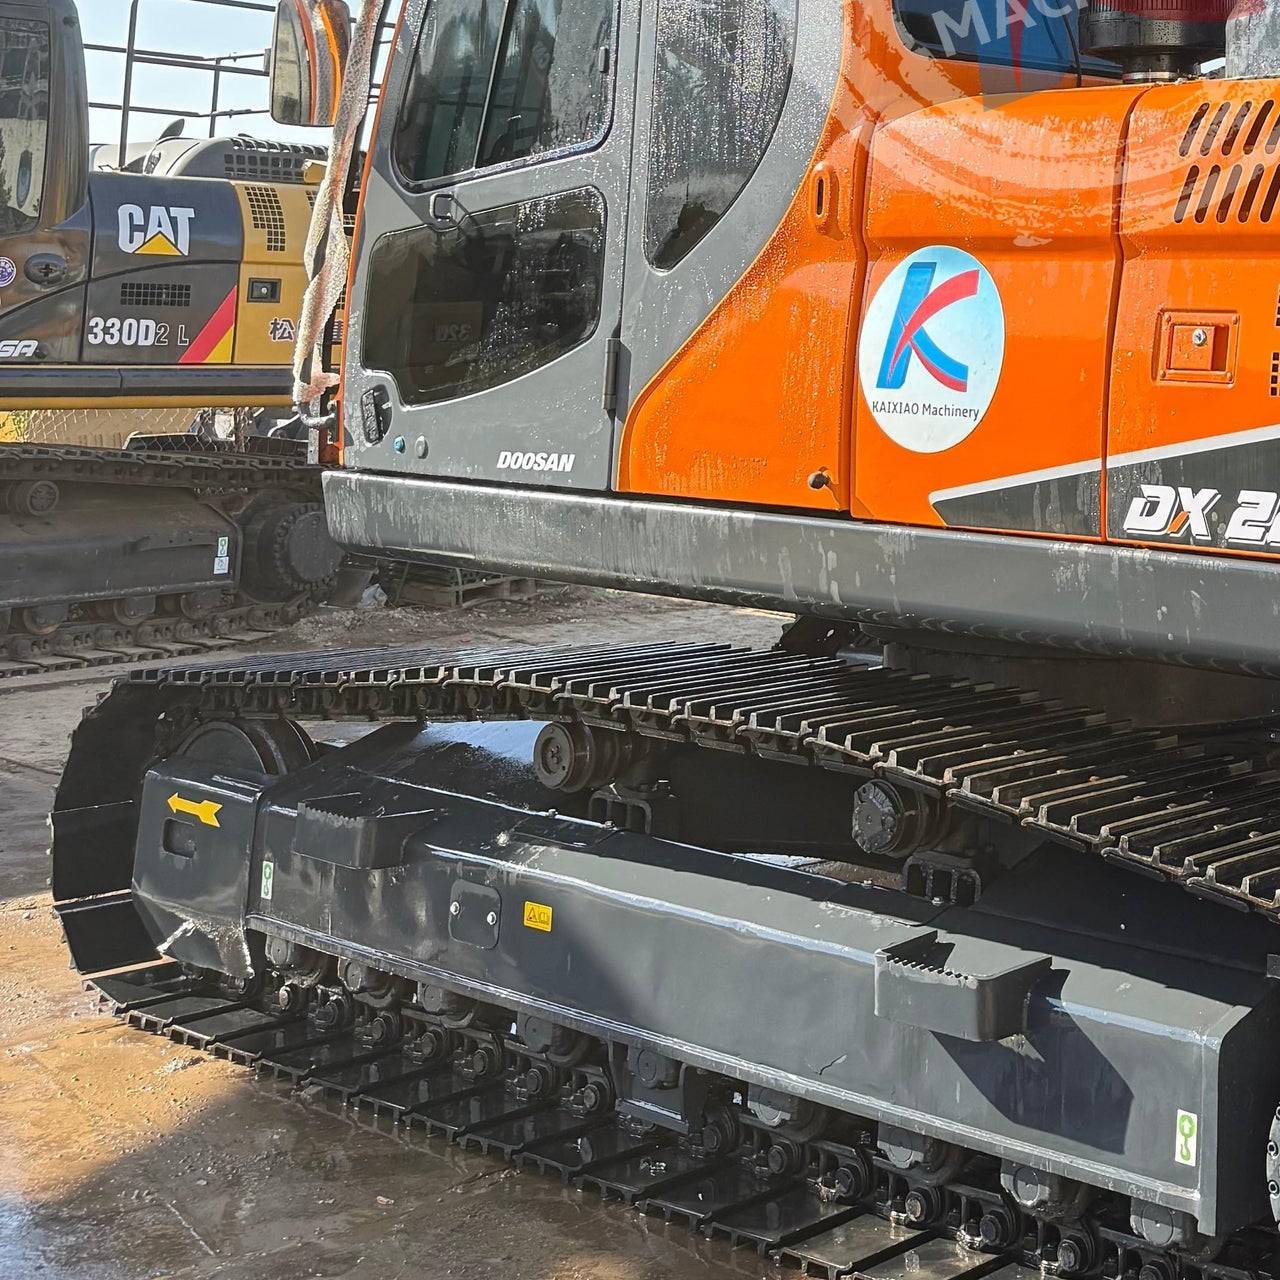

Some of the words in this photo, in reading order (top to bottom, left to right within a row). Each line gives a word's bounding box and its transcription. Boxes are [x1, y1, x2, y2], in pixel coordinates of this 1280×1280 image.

[117, 203, 195, 256] CAT
[87, 316, 170, 346] 330D2
[177, 324, 190, 346] L
[269, 317, 299, 342] 松
[872, 400, 919, 415] KAIXIAO
[922, 403, 980, 422] Machinery
[496, 451, 576, 472] DOOSAN
[1123, 484, 1222, 540] DX
